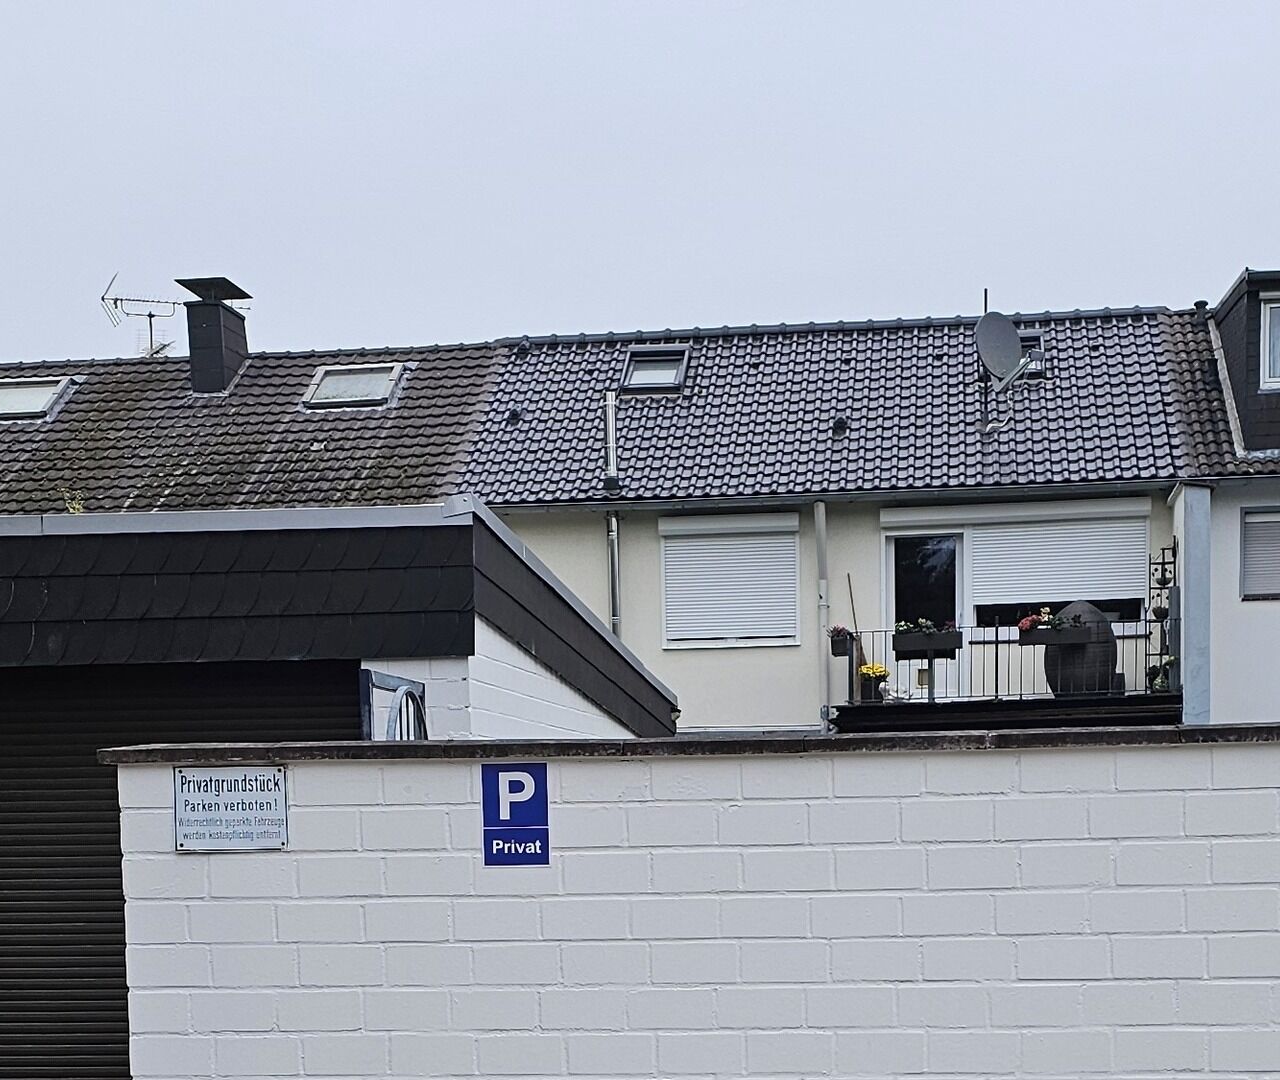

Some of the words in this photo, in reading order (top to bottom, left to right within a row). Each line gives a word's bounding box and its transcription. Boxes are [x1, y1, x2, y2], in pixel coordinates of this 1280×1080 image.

[180, 773, 281, 797] Privatgrundstück
[499, 771, 535, 820] P
[184, 799, 220, 812] Parken
[492, 840, 542, 854] Privat
